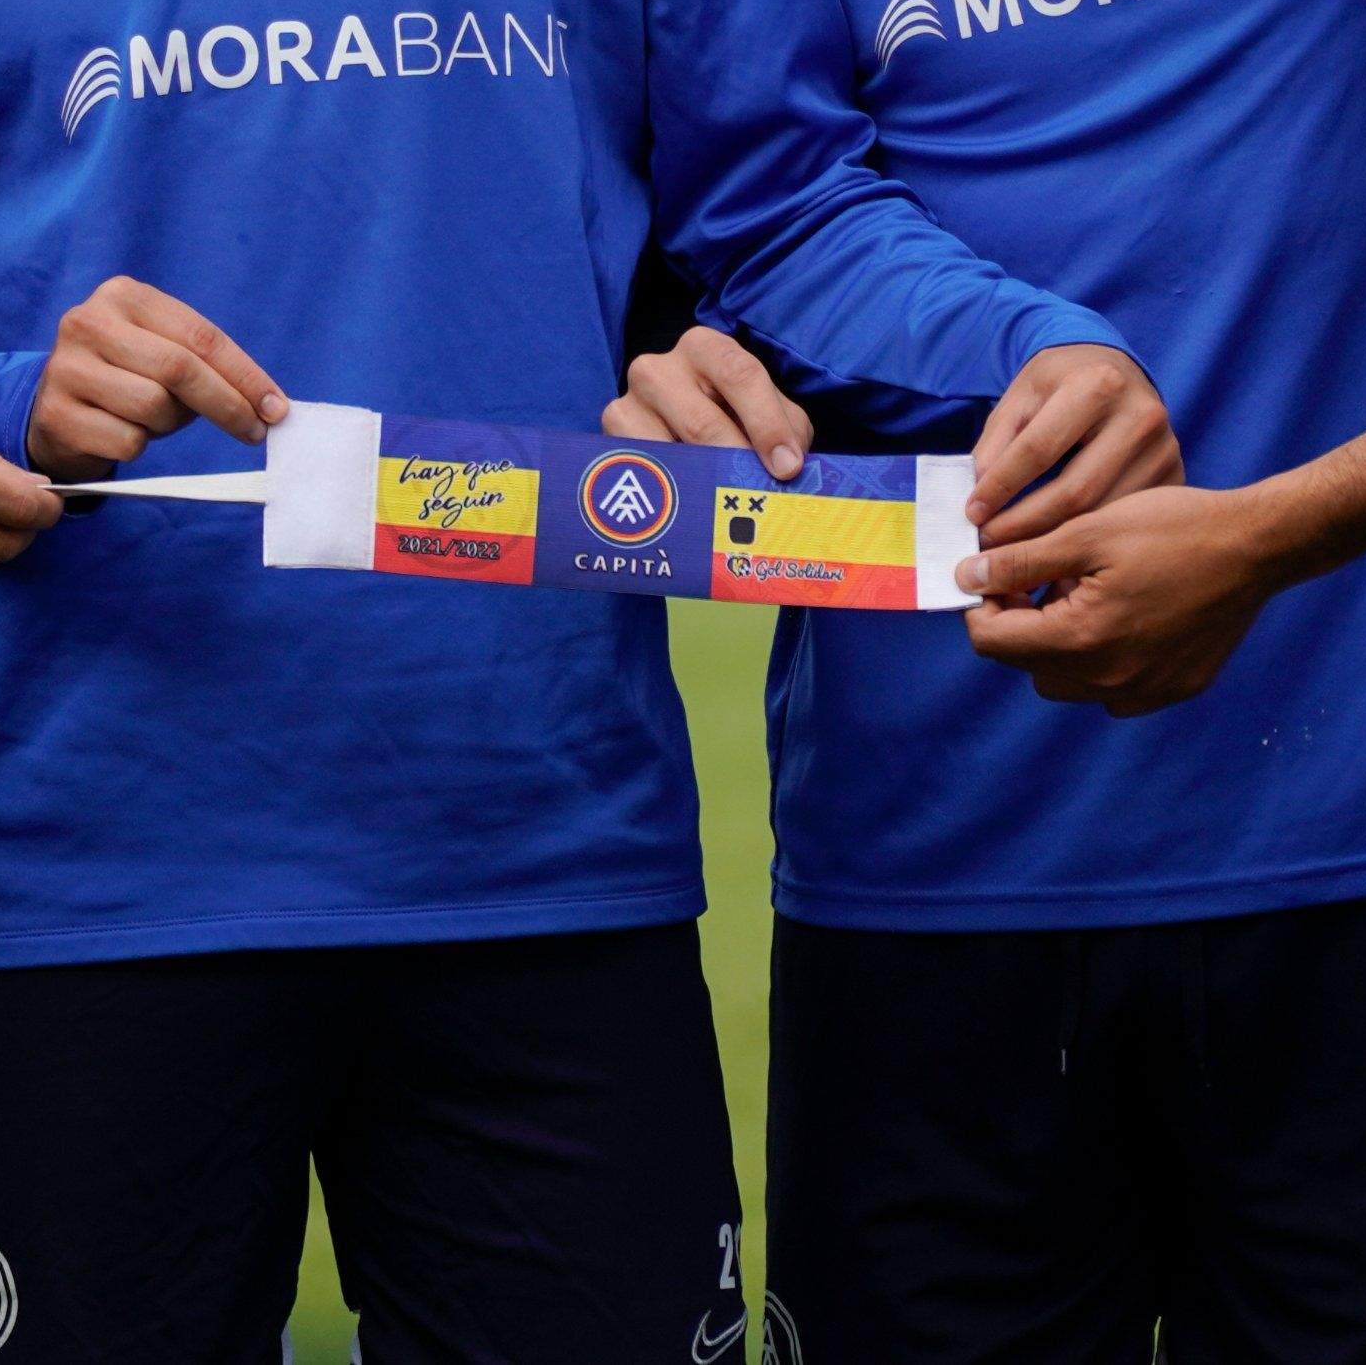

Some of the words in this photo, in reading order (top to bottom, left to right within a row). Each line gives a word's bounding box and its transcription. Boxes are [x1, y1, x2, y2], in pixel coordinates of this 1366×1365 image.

[399, 455, 458, 498] hay
[462, 460, 515, 491] que
[398, 535, 501, 560] 2021/2022
[574, 548, 672, 577] CAPITÀ
[755, 560, 783, 581] Gol
